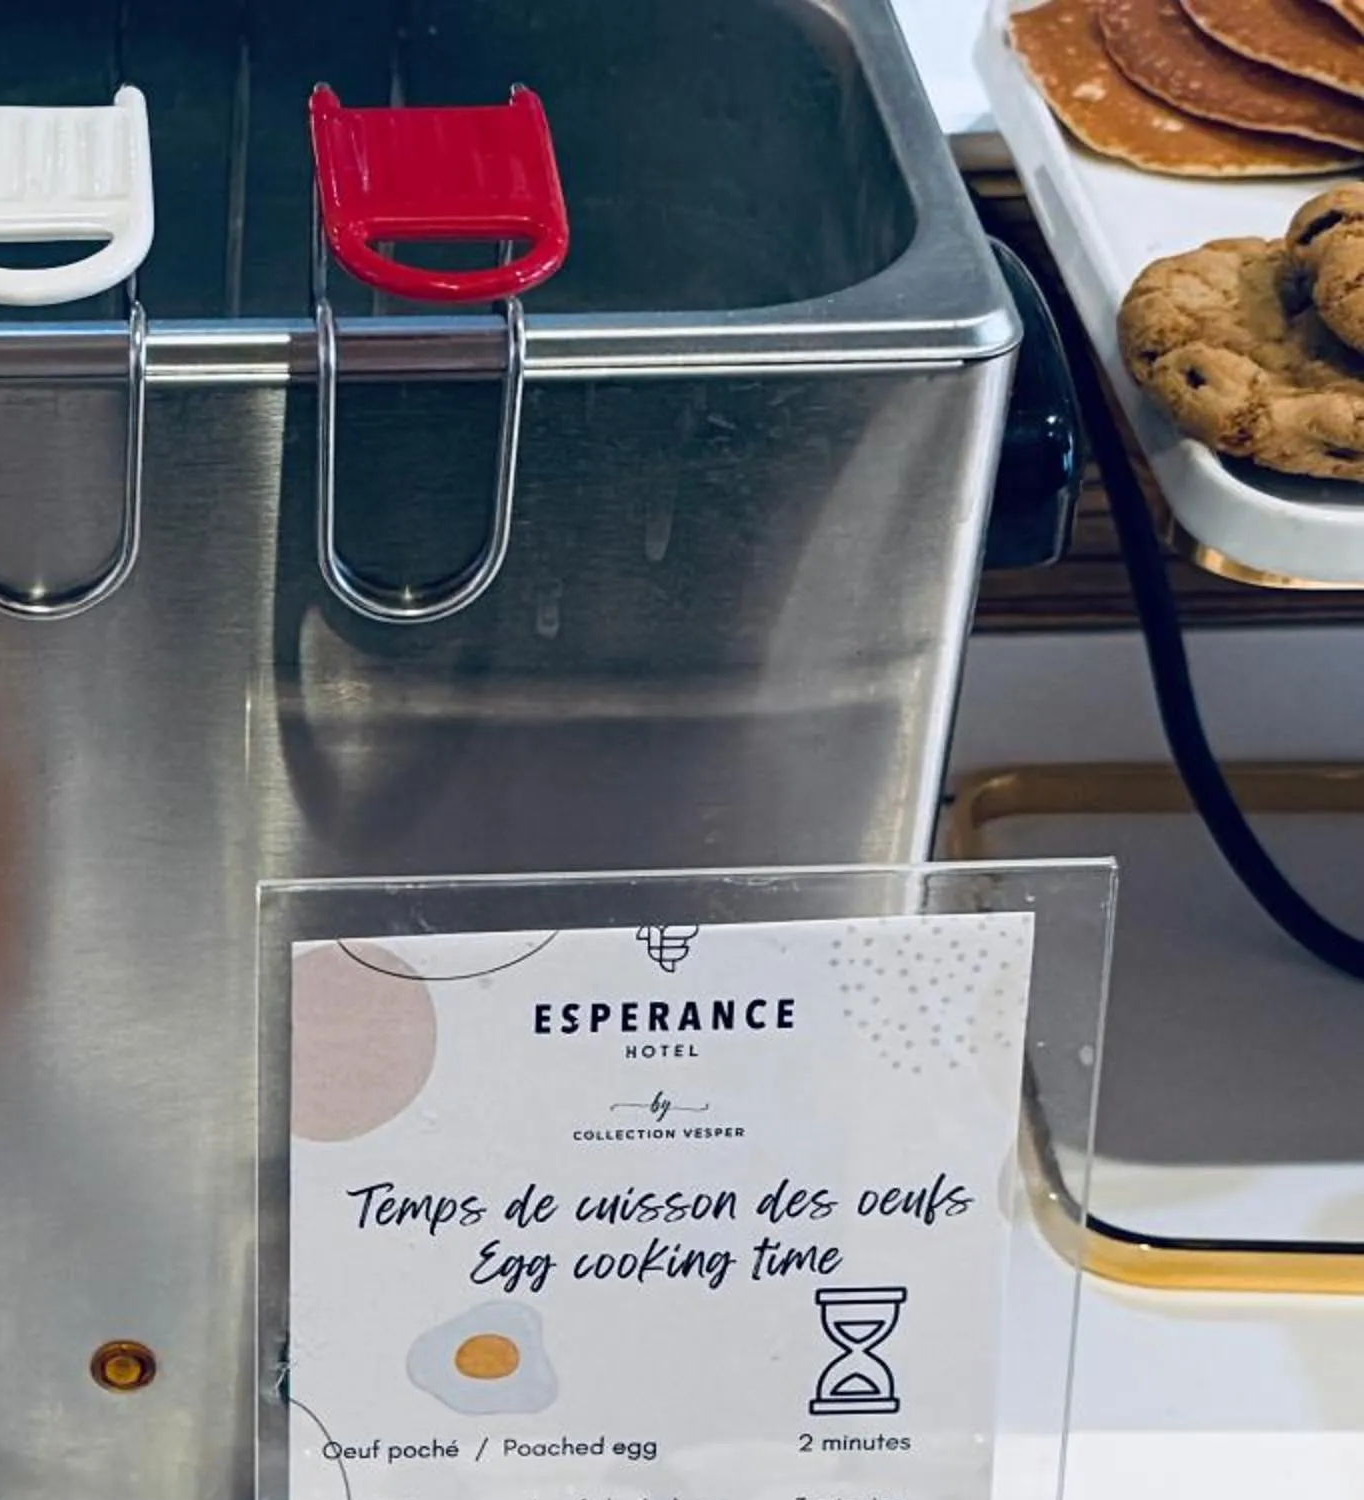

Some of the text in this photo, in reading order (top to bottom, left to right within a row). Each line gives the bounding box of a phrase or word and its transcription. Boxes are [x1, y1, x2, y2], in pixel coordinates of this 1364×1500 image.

[533, 997, 796, 1035] ESPERANCE
[625, 1042, 699, 1060] HOTEL
[649, 1089, 672, 1123] by
[572, 1123, 746, 1142] COLLECTION VESPER
[345, 1171, 976, 1236] Temps de cuisson des oeufs
[469, 1235, 844, 1294] Egg cooking time
[321, 1435, 658, 1465] Oeuf poché / Poached egg
[798, 1432, 912, 1453] 2 minutes
